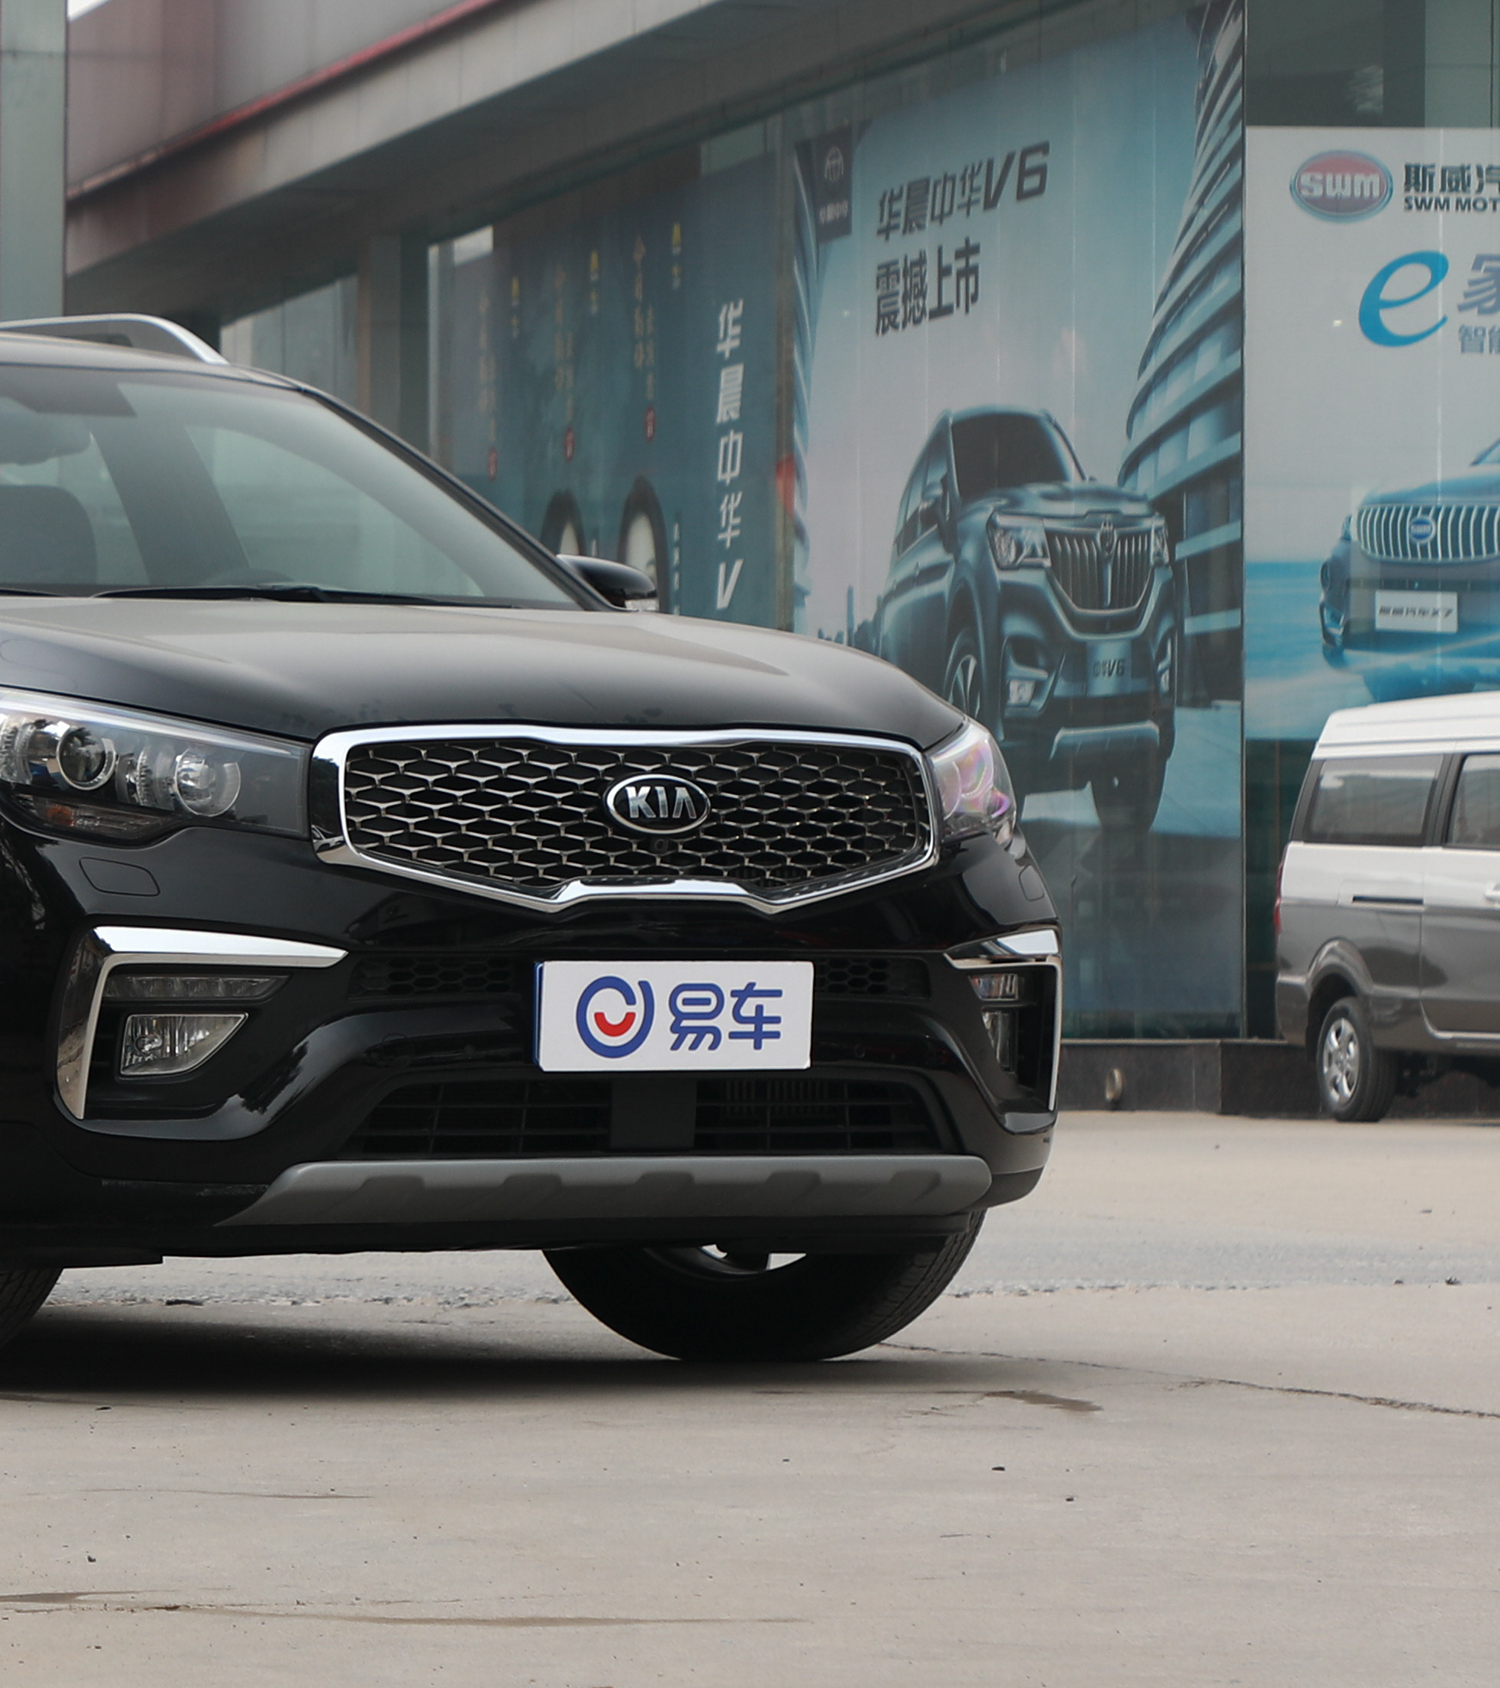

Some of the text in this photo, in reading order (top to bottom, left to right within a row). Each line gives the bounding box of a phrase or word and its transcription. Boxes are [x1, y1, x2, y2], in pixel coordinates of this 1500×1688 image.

[877, 140, 1050, 241] 华晨中华V6
[1300, 171, 1381, 199] SWM
[1404, 197, 1450, 212] SWM
[875, 236, 981, 336] 震撼上市
[625, 786, 697, 819] KIA
[668, 981, 783, 1051] 易车
